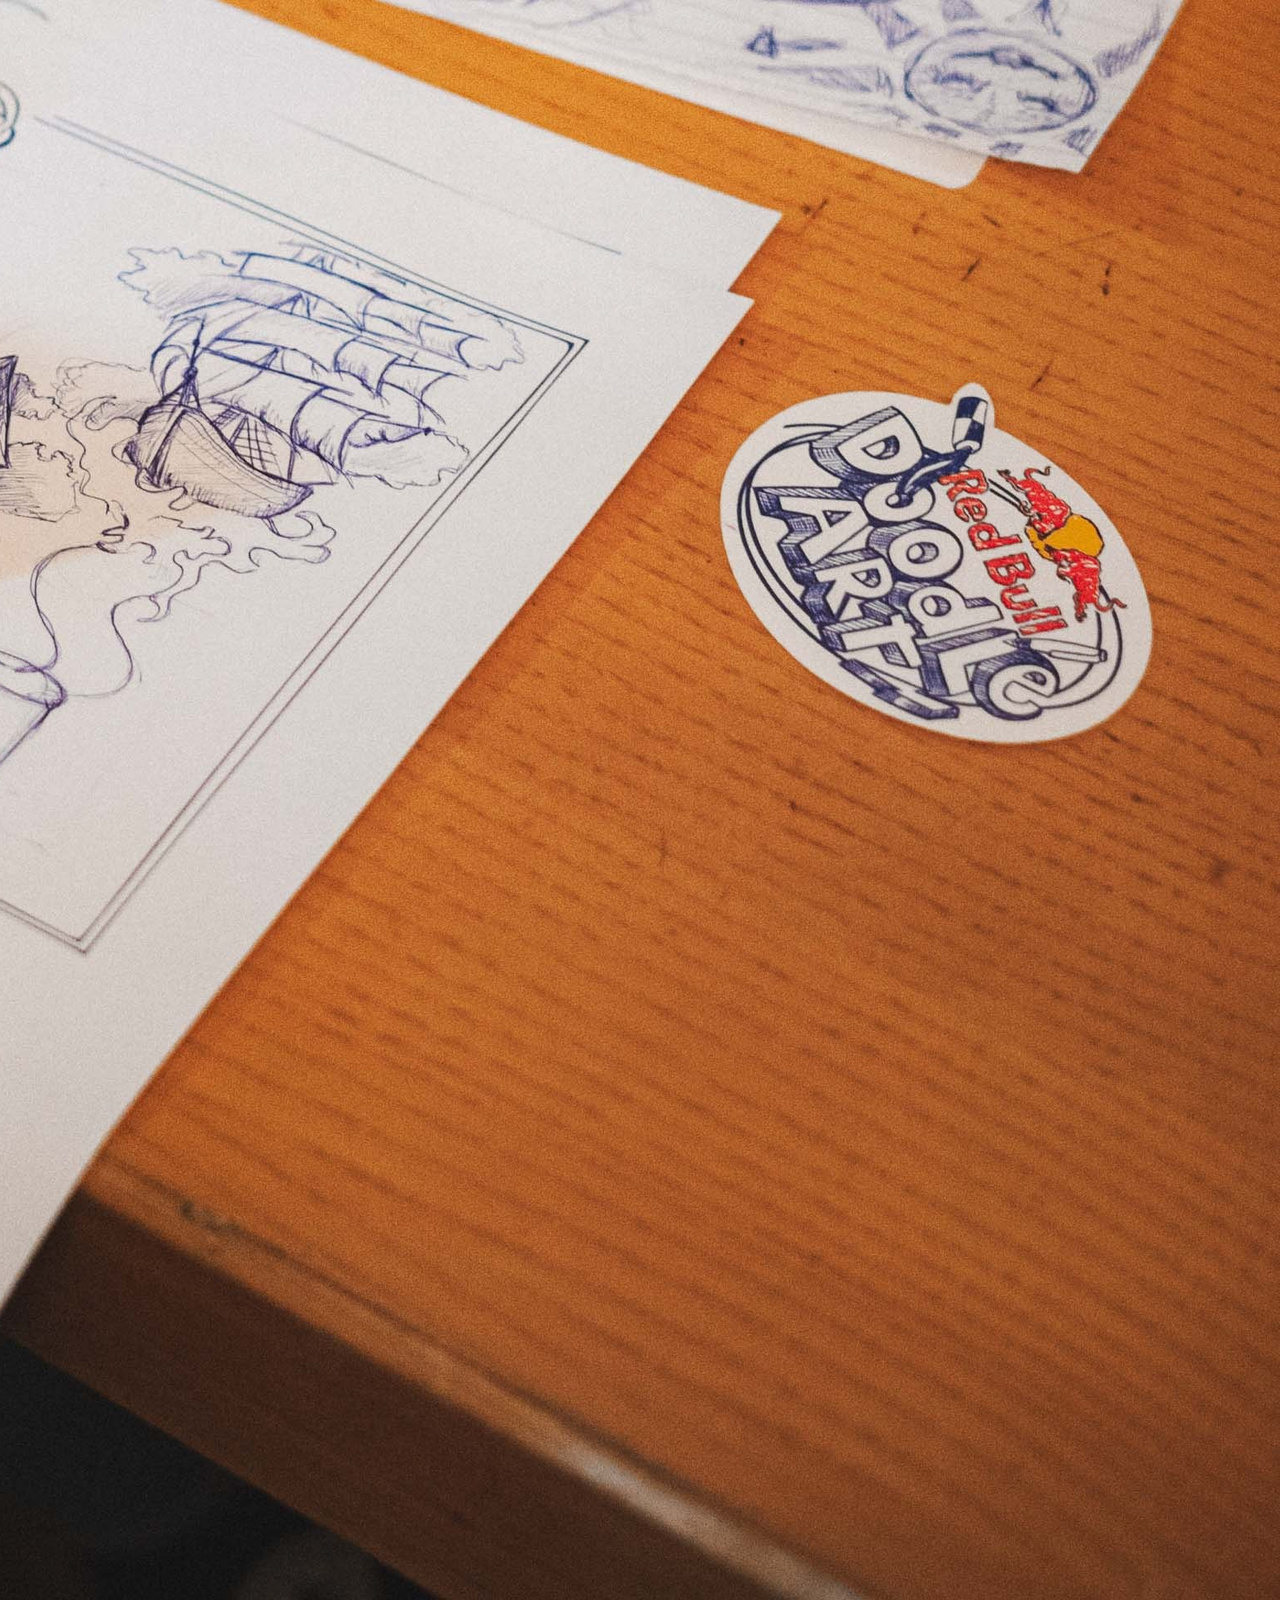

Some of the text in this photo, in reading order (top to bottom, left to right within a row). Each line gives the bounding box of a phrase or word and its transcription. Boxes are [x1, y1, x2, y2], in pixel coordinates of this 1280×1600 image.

[754, 485, 923, 672] ART
[937, 467, 1069, 637] Red Bull
